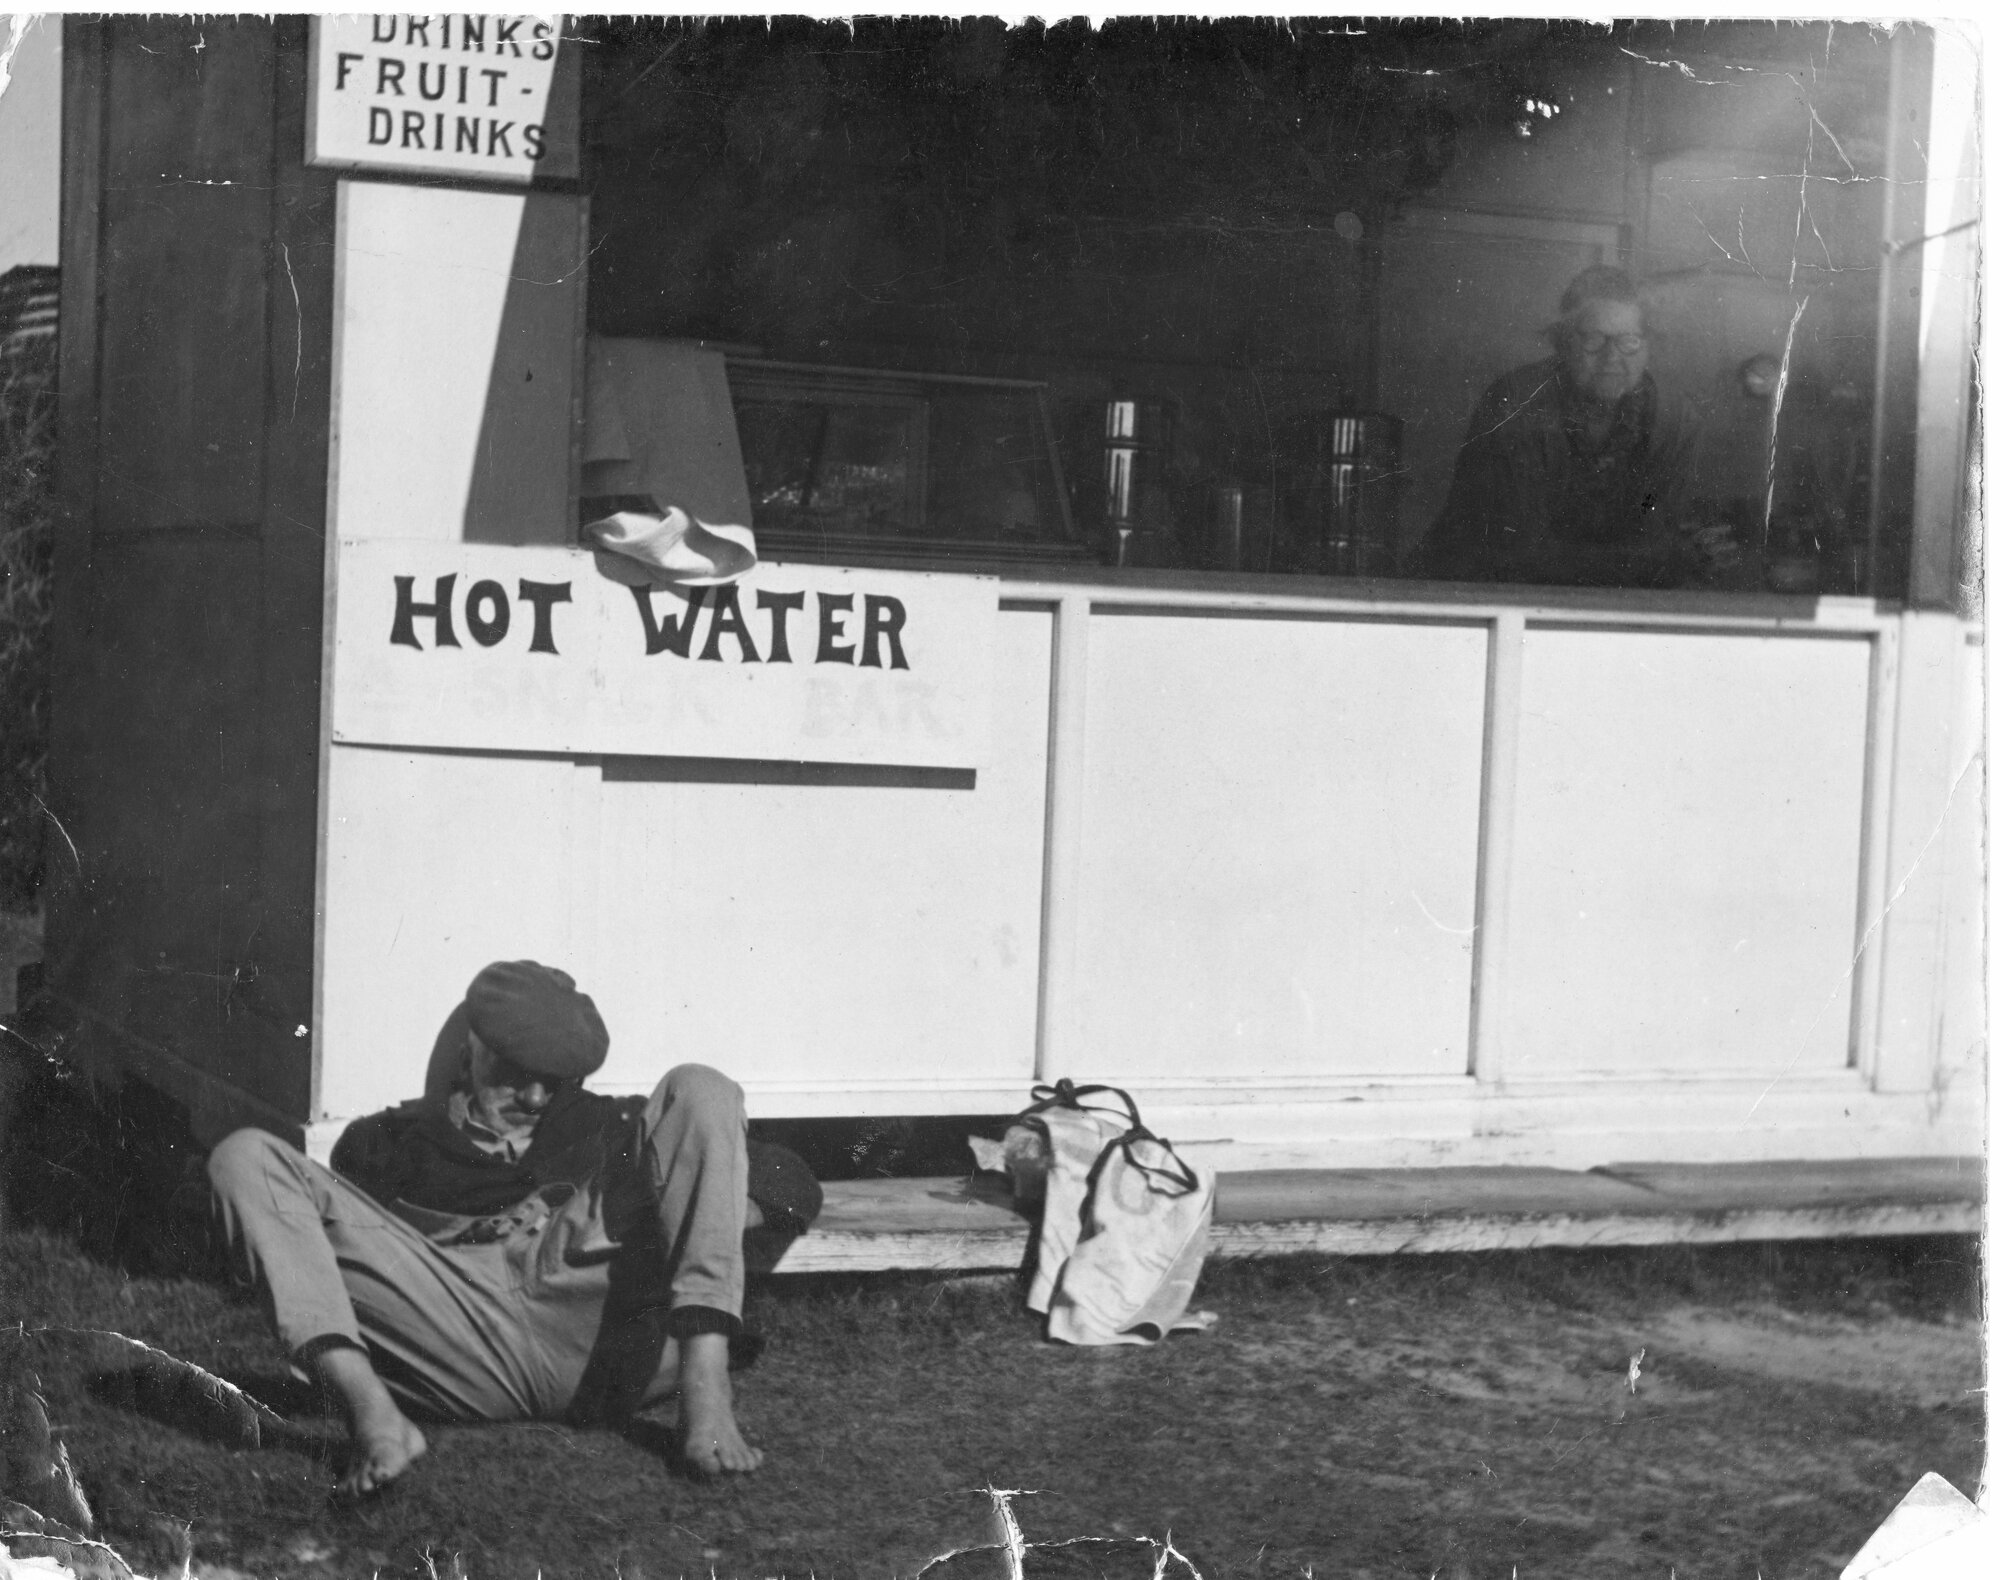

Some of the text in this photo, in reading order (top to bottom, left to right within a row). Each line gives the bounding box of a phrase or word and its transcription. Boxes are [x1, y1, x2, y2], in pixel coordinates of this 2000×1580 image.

[372, 15, 554, 60] DRINKS
[336, 52, 533, 107] FRUIT-
[367, 106, 547, 161] DRINKS
[390, 573, 911, 671] HOT WATER
